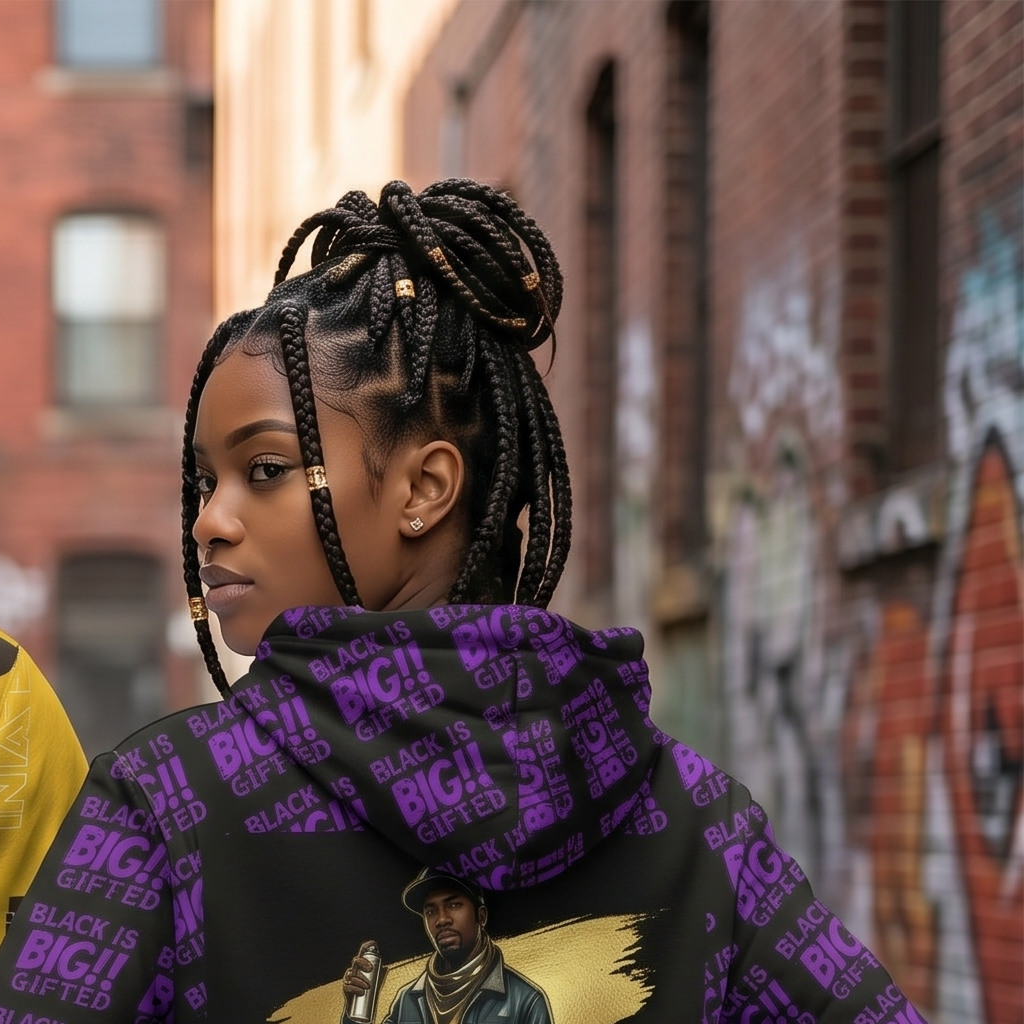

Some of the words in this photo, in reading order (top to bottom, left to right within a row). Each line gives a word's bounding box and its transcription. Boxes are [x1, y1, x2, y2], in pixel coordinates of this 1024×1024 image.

[308, 632, 384, 684] BLACK
[384, 620, 411, 646] IS
[186, 684, 268, 739] BLACK
[270, 674, 296, 699] IS
[330, 640, 431, 726] BIG!!
[355, 683, 446, 742] GIFTED
[369, 734, 445, 785] BLACK
[445, 720, 472, 746] IS
[391, 741, 496, 828] BIG!!
[417, 788, 508, 844] GIFTED
[436, 838, 505, 878] LACK
[56, 868, 161, 911] GIFTED
[30, 903, 110, 940] BLACK
[112, 926, 139, 950] IS
[11, 971, 111, 1011] GIFTED
[15, 929, 130, 992] BIG!!
